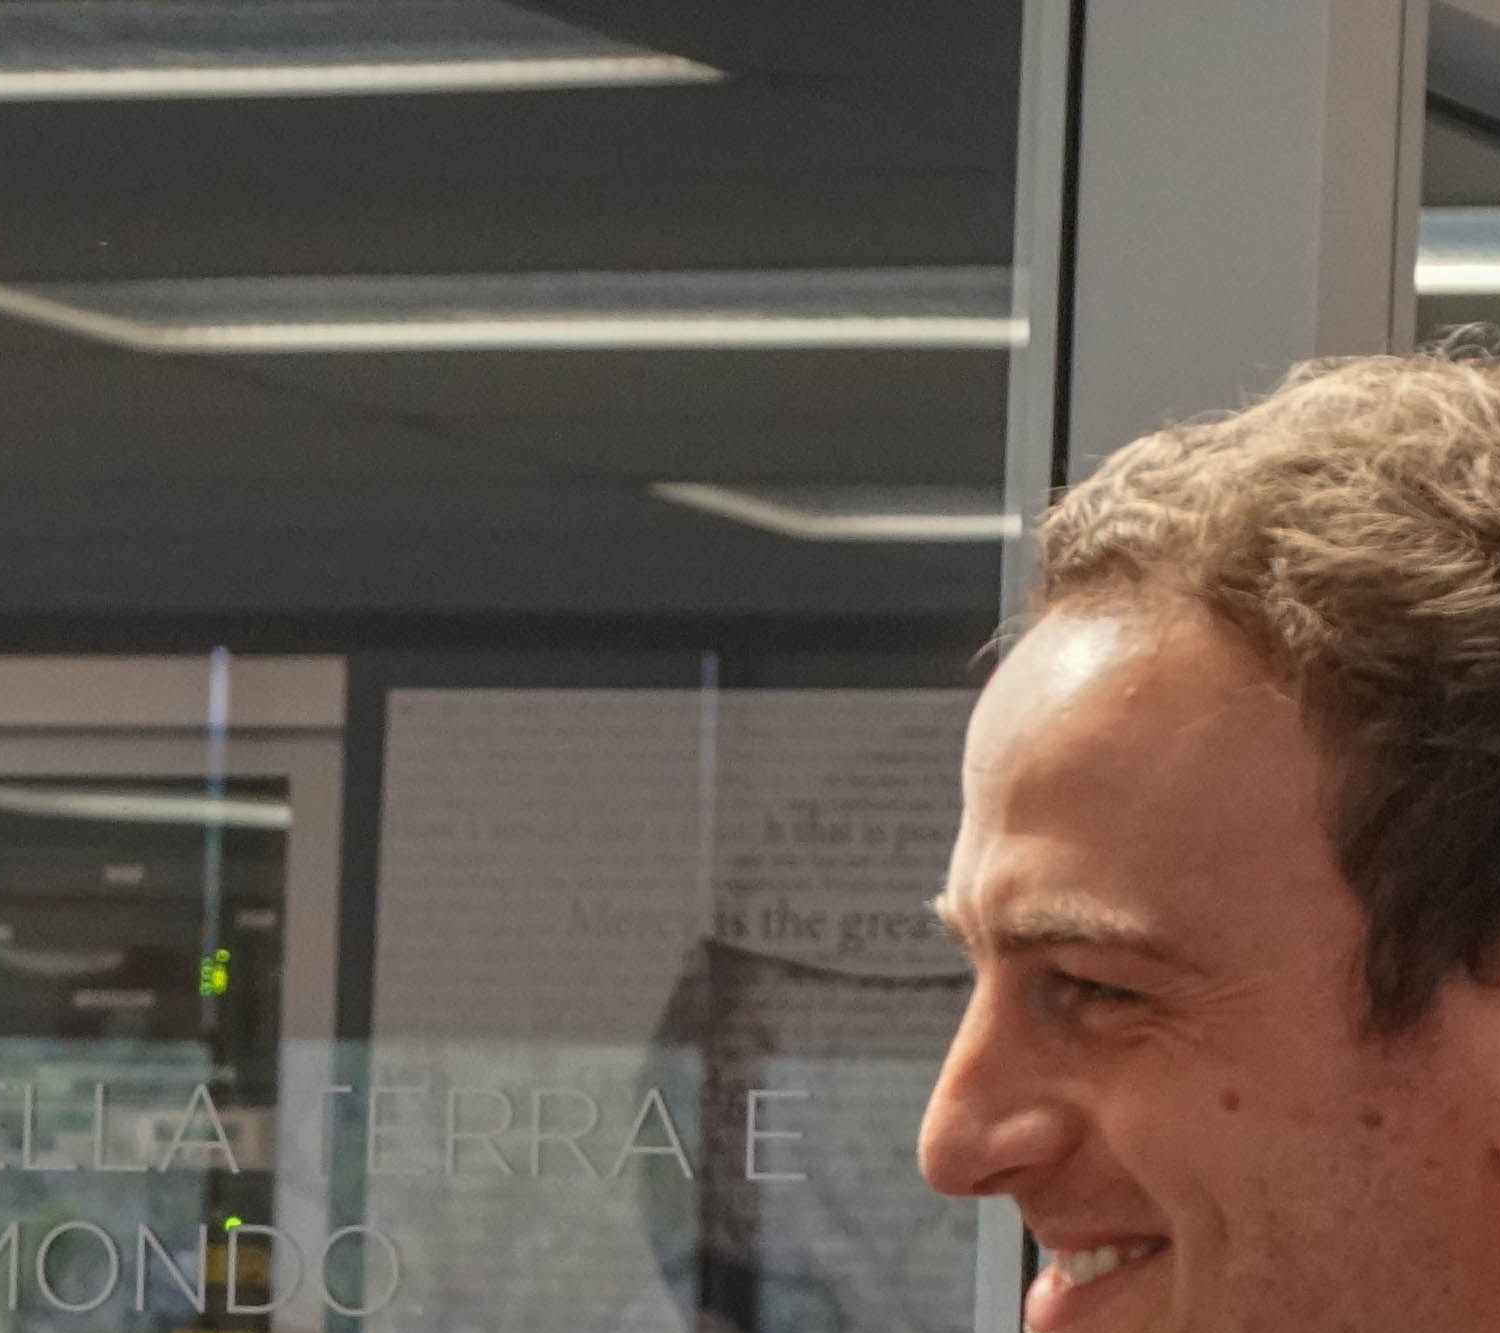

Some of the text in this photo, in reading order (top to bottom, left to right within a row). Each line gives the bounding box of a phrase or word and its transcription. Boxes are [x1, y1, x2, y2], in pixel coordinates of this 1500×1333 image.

[759, 896, 828, 940] the
[836, 908, 932, 954] grea
[310, 1086, 695, 1181] TERRA
[745, 1089, 810, 1182] E
